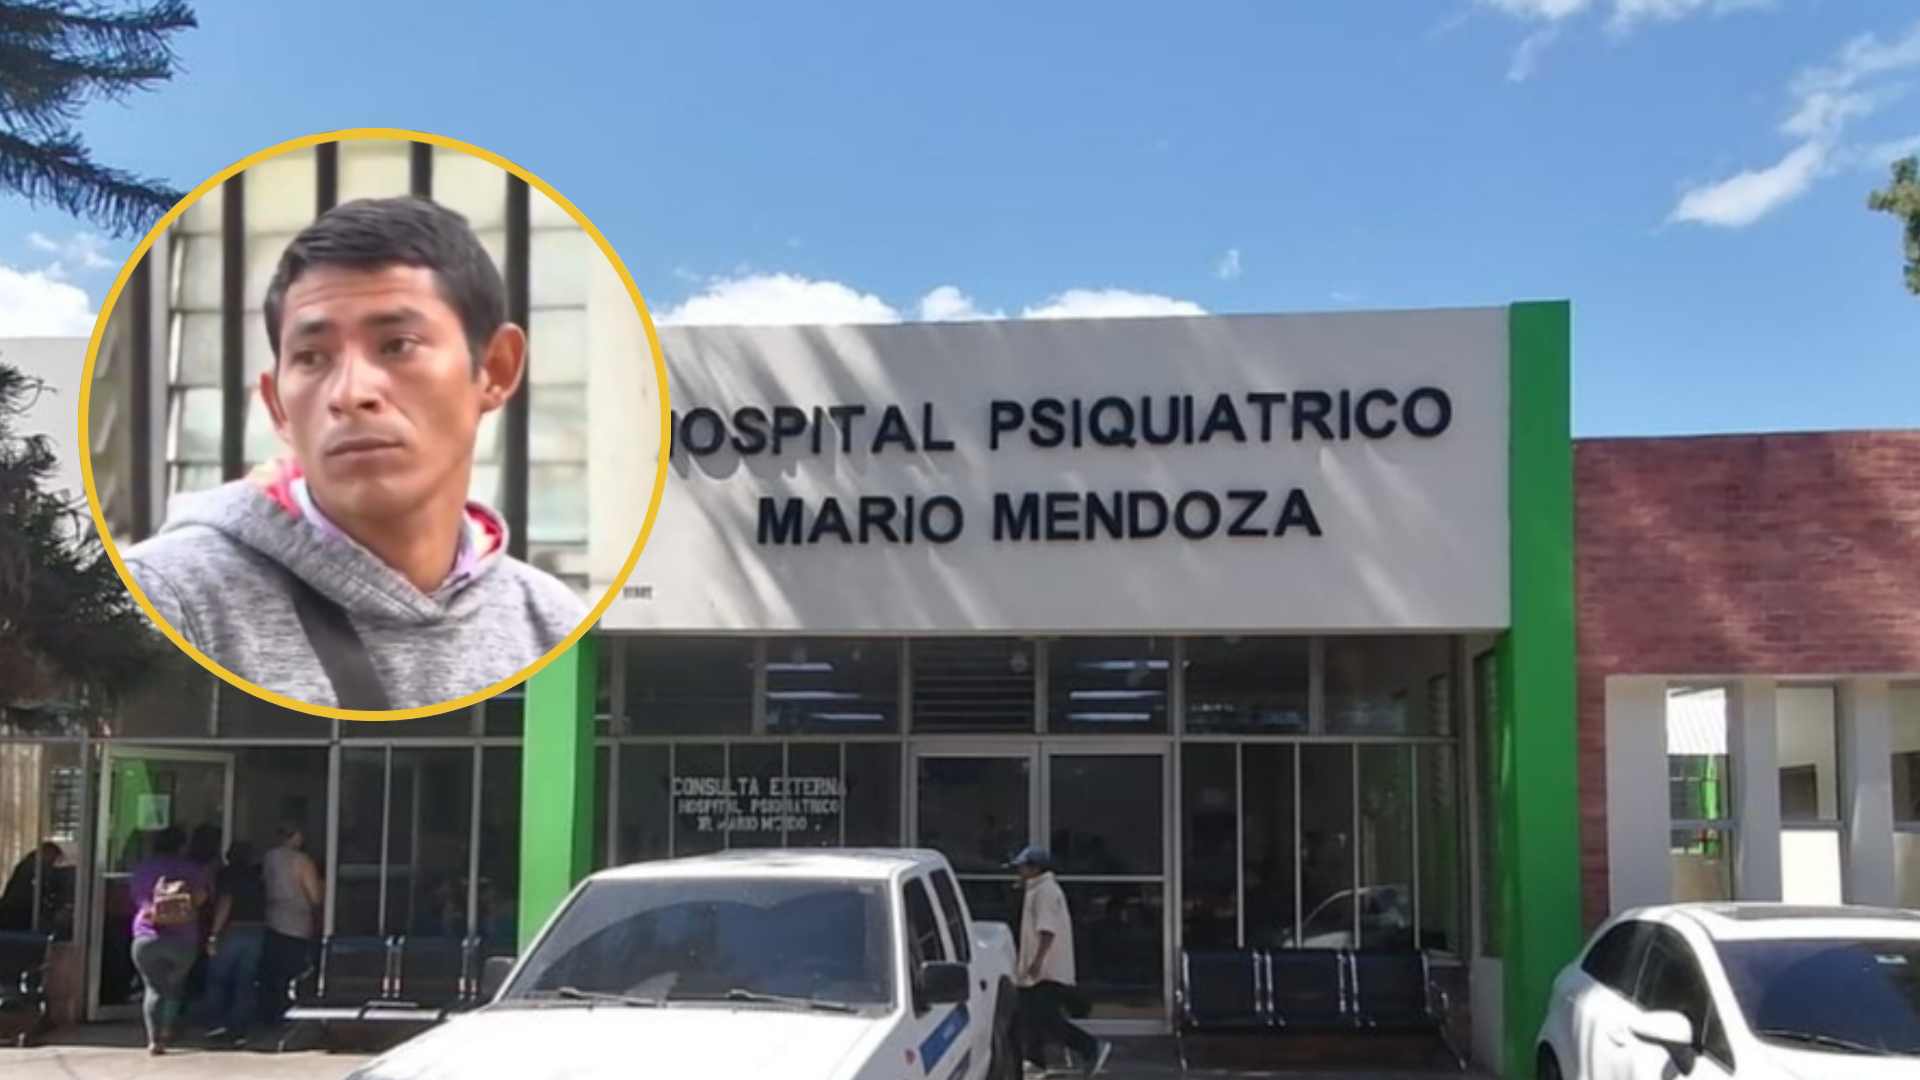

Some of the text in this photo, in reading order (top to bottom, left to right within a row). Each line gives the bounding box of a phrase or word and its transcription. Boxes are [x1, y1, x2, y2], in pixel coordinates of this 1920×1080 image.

[670, 386, 1453, 459] OSPITAL PSIQUIATRICO
[756, 488, 1323, 546] MARIO MENDOZA
